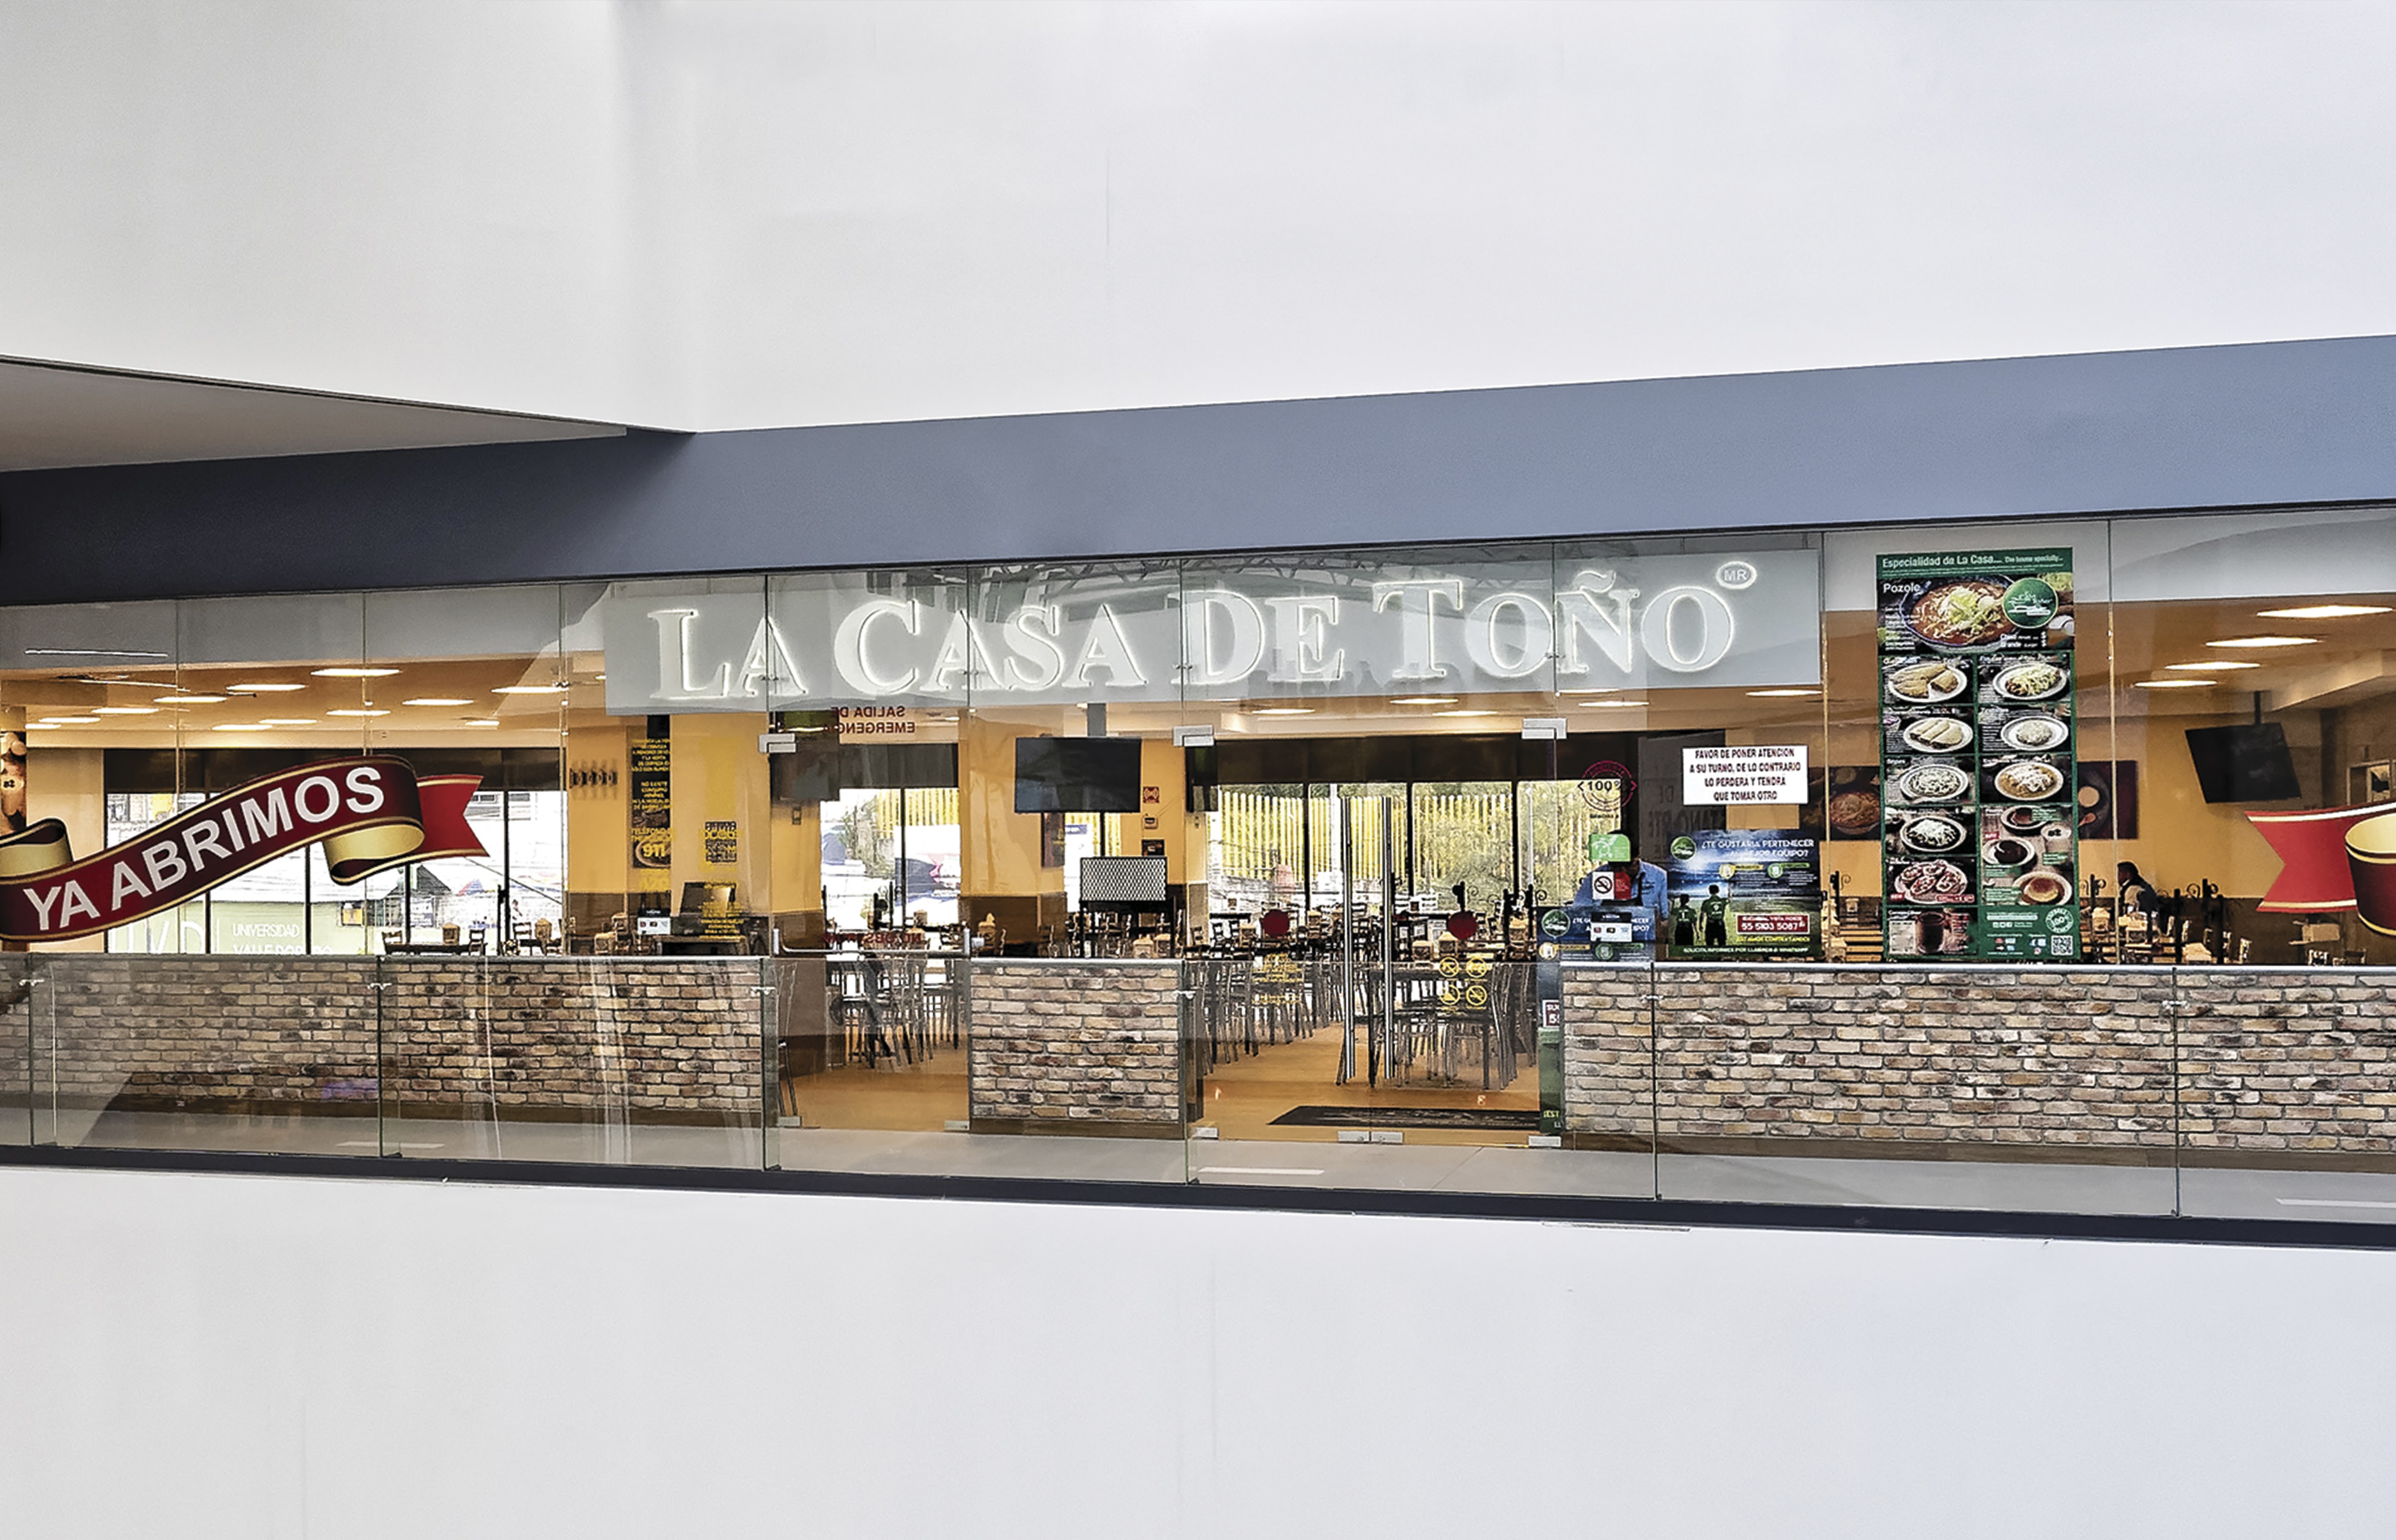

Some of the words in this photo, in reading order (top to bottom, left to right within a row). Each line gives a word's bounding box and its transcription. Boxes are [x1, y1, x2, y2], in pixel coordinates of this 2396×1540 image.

[1882, 557, 1941, 569] Especialidad
[1957, 556, 1968, 565] La
[1723, 569, 1748, 581] MR
[1883, 582, 1921, 594] Pozole
[648, 609, 809, 700] LA
[833, 599, 1148, 695] CASA
[1165, 589, 1345, 685] DE
[1372, 569, 1735, 679] TOÑO
[1695, 749, 1719, 759] FAVOR
[1720, 749, 1729, 758] DE
[1731, 748, 1757, 758] PONER
[1689, 764, 1696, 773] A
[1697, 764, 1707, 773] SU
[1736, 763, 1746, 772] DE
[1747, 762, 1757, 772] LO
[1758, 762, 1801, 772] CONTRARIO
[1704, 778, 1714, 787] LO
[1750, 777, 1756, 786] Y
[1713, 791, 1729, 801] QUE
[1730, 791, 1755, 801] TOMAR
[1756, 791, 1778, 800] OTRO
[22, 880, 101, 931] YA
[111, 766, 386, 912] ABRIMOS
[1762, 839, 1815, 848] PERTENECER
[1772, 850, 1809, 858] EQUIPO?
[232, 924, 300, 937] UNIVERSIDAD
